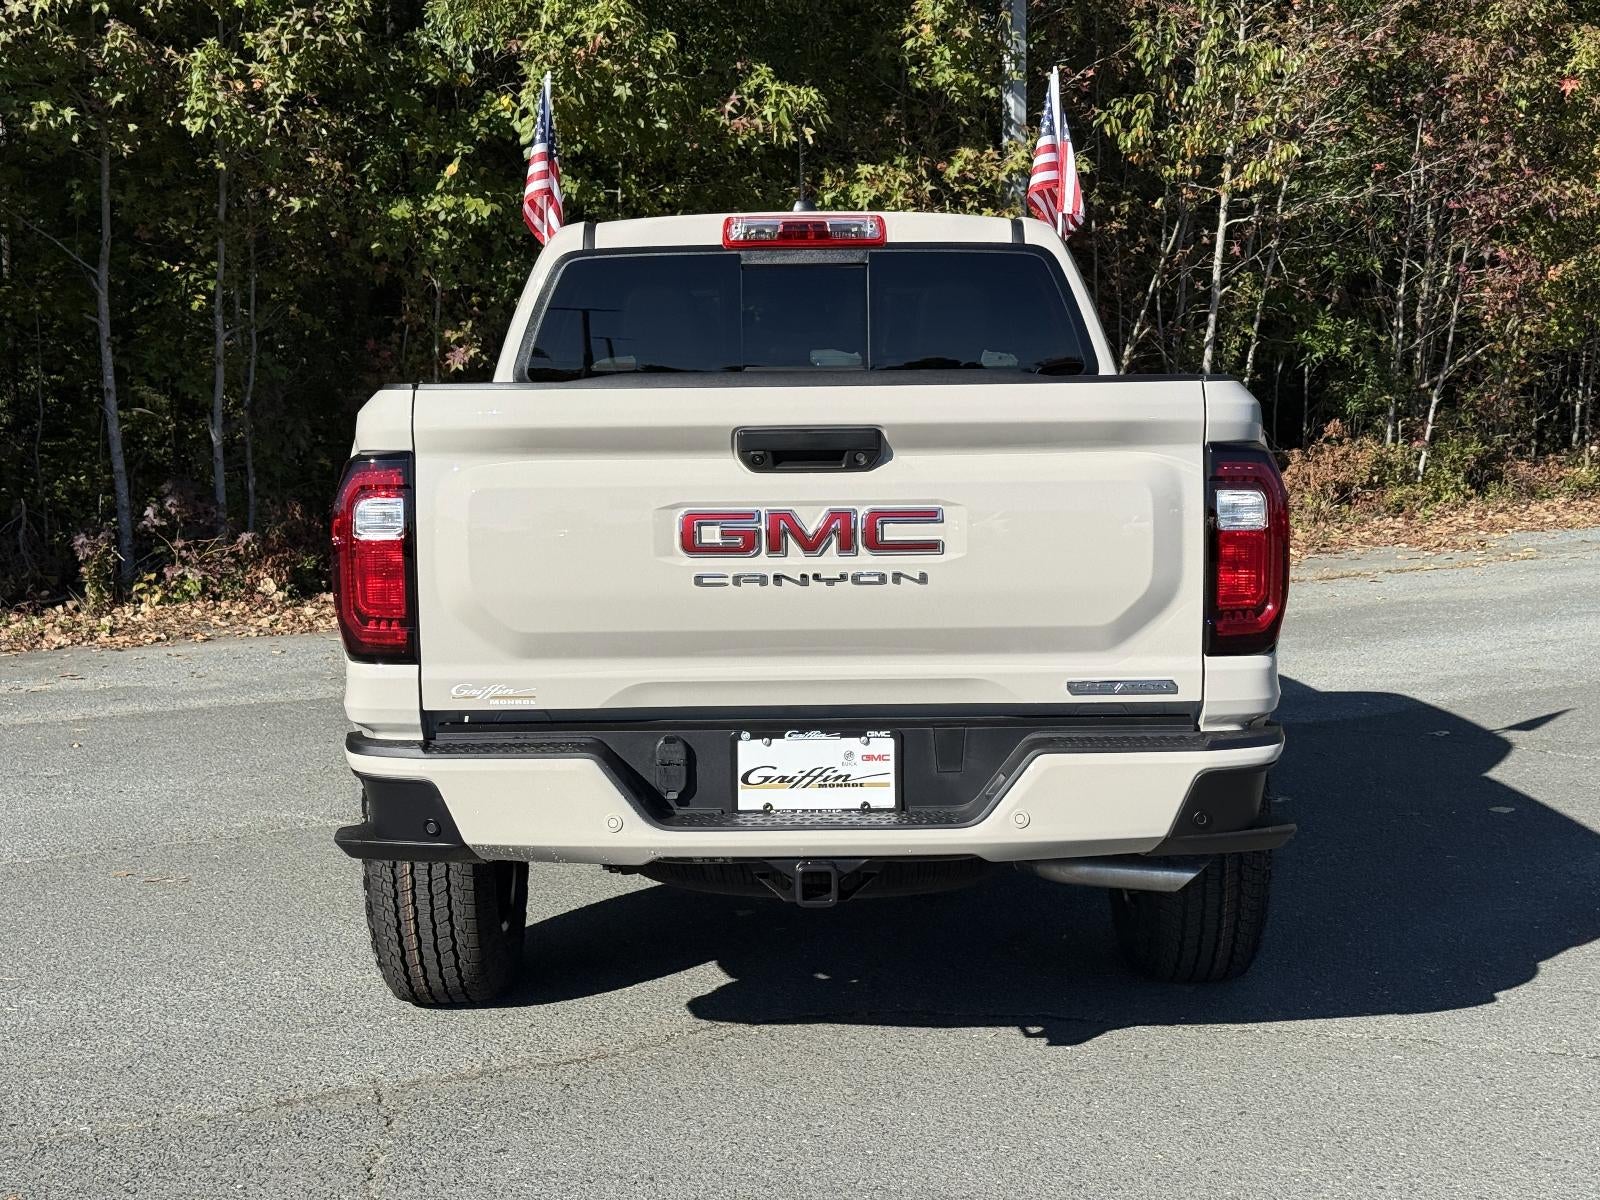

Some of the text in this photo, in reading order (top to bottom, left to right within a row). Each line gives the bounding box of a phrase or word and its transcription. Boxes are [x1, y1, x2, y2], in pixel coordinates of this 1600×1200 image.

[679, 507, 945, 558] GMC
[693, 571, 929, 587] CANYON
[450, 682, 536, 700] Griffin
[866, 730, 891, 738] GMC
[861, 754, 891, 762] GMC
[740, 765, 891, 789] Griffin
